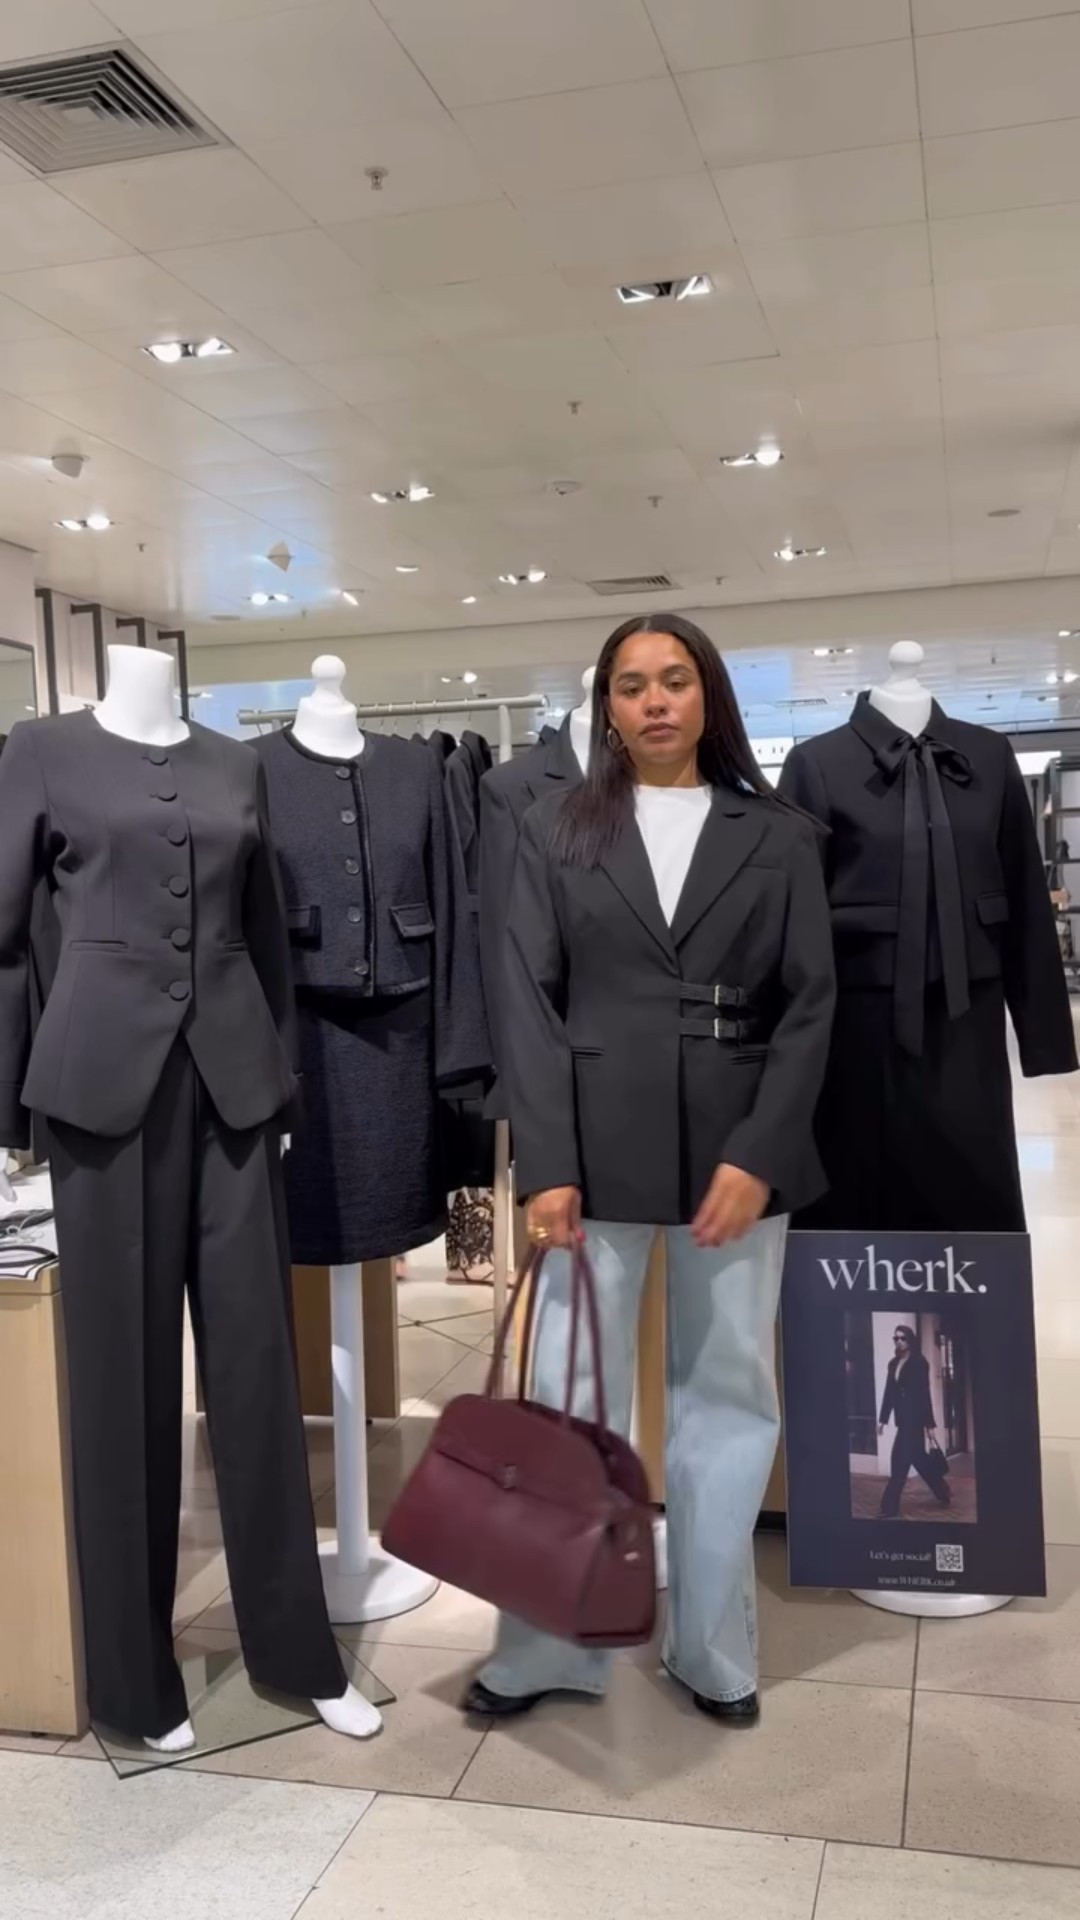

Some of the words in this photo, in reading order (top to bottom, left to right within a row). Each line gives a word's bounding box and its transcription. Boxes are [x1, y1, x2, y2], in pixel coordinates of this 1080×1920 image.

[817, 1244, 988, 1294] wherk.
[869, 1549, 889, 1560] Let's
[890, 1552, 904, 1562] get
